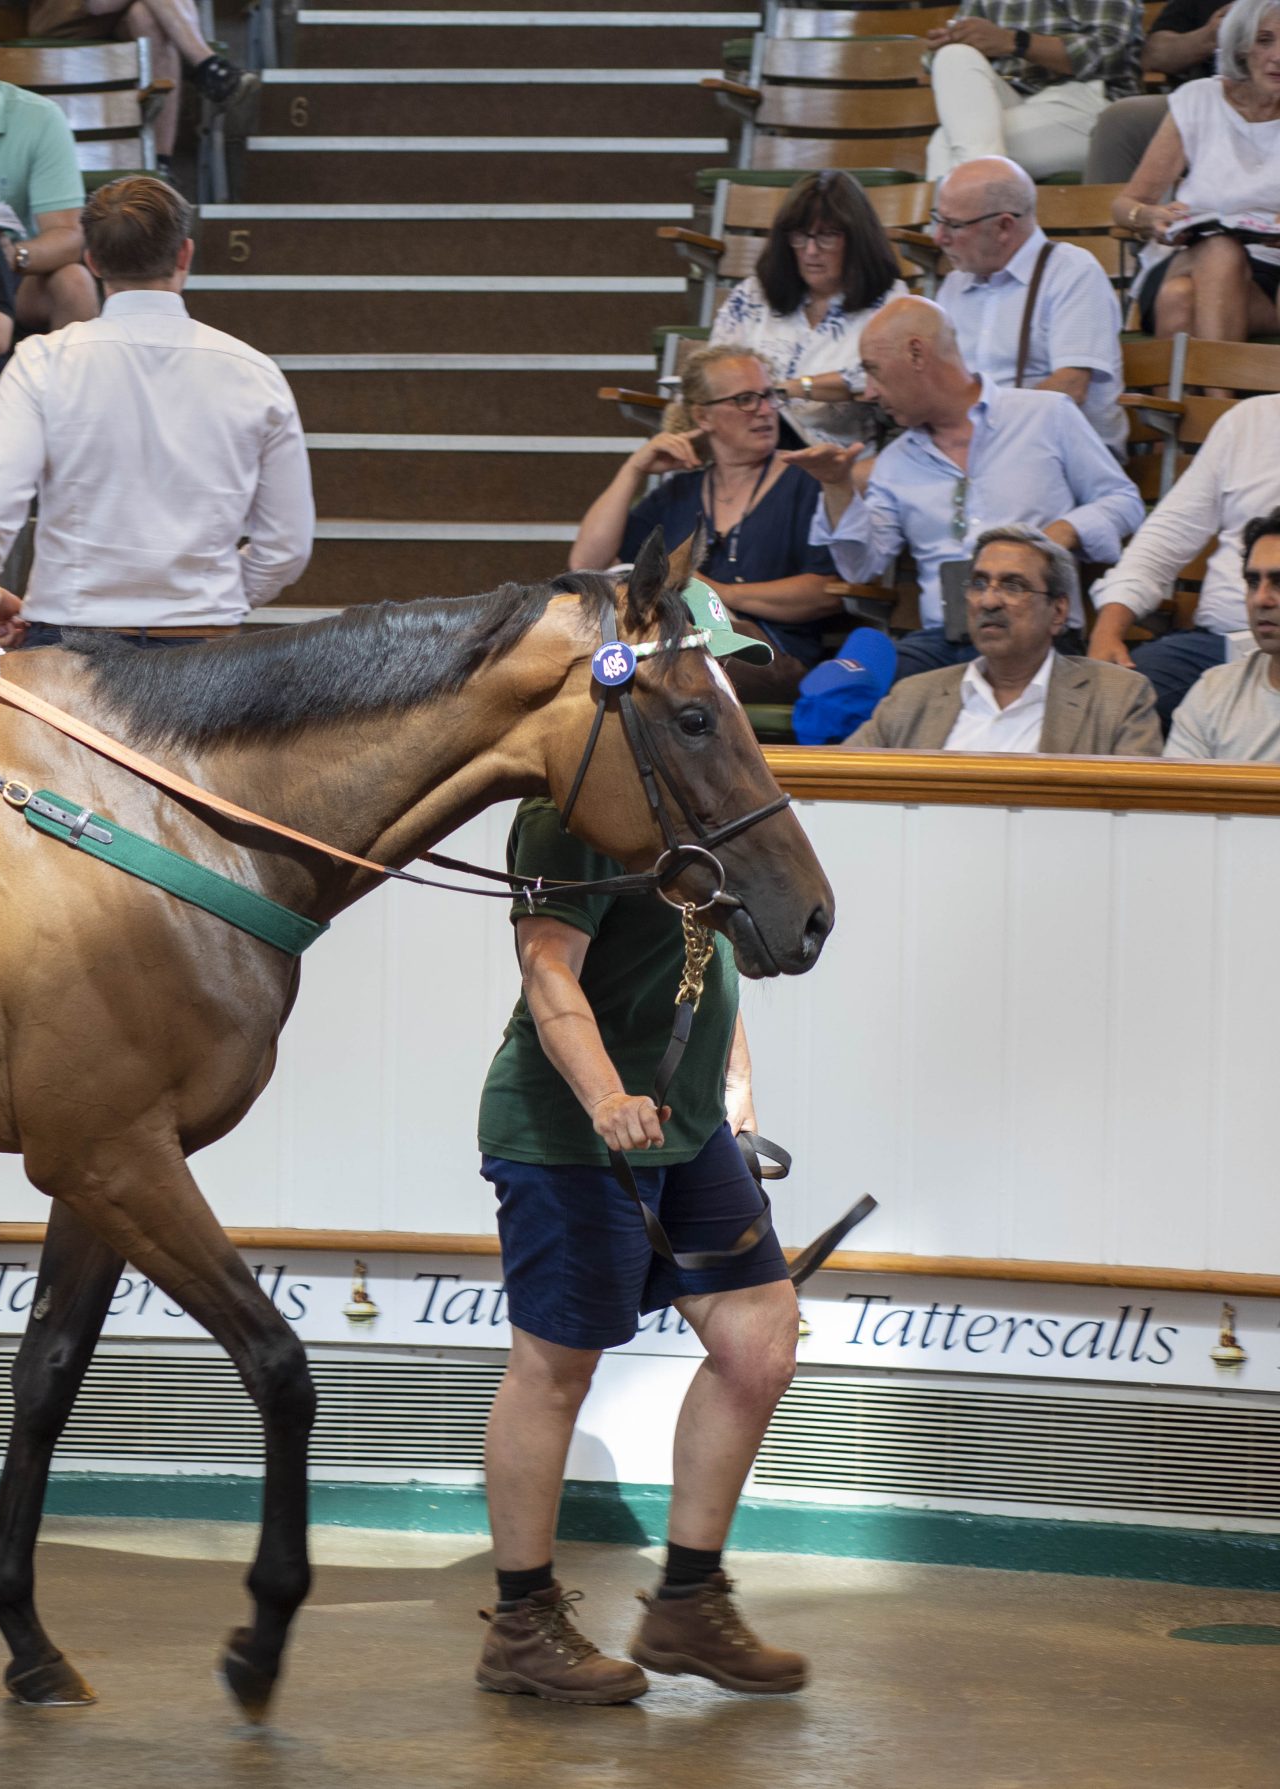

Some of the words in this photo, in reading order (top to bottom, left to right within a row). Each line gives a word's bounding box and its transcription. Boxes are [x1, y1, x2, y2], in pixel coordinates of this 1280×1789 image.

[290, 96, 309, 127] 6
[228, 229, 251, 262] 5
[603, 651, 628, 679] 495
[843, 1292, 1180, 1365] Tattersalls
